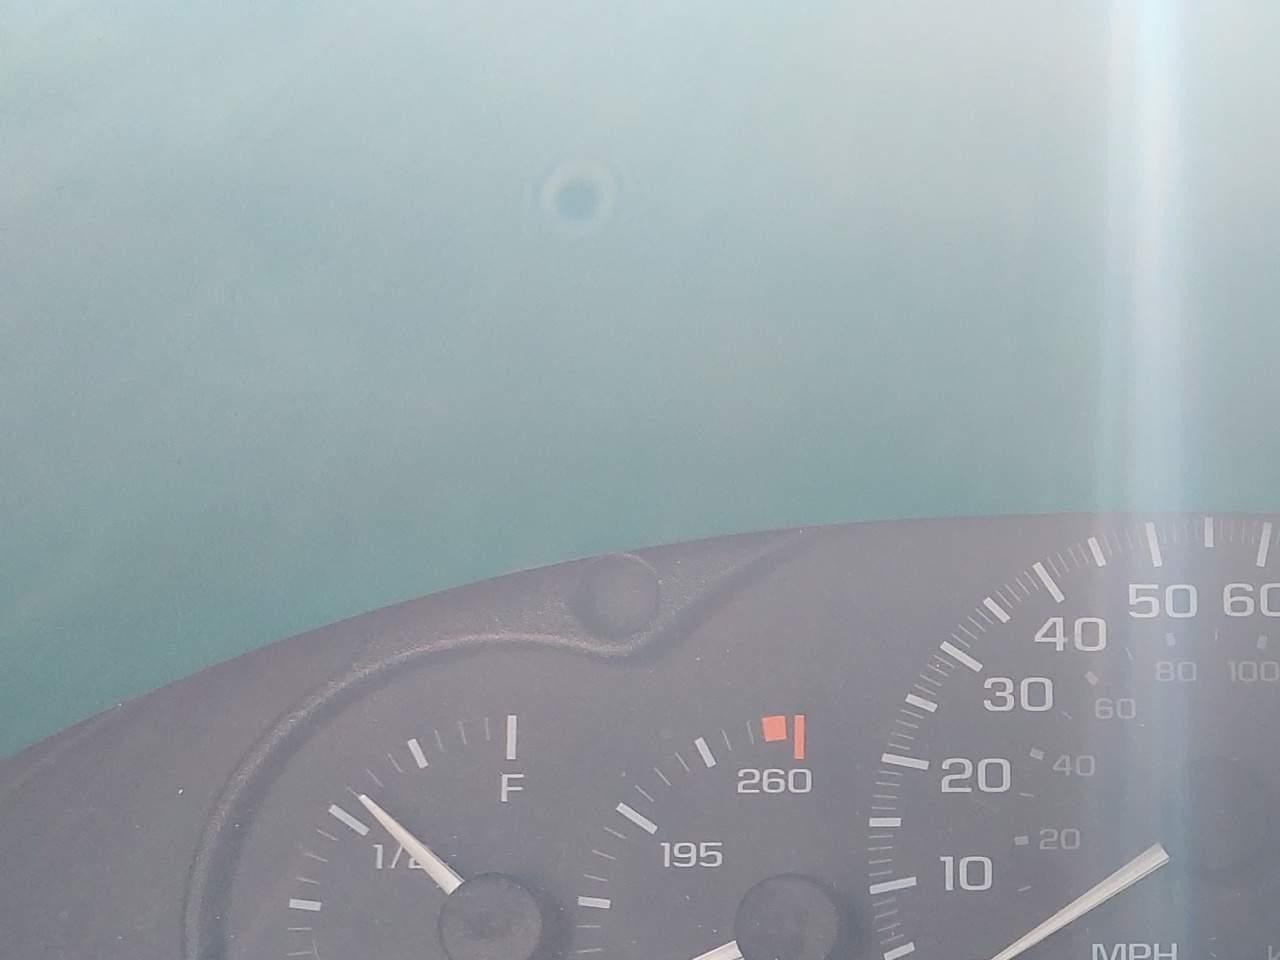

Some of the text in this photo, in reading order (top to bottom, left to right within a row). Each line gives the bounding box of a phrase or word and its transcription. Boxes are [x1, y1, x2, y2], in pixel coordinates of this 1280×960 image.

[1128, 583, 1198, 619] 50
[1033, 617, 1107, 652] 40
[1155, 660, 1197, 682] 80
[1228, 661, 1280, 682] 100
[983, 676, 1054, 712] 30
[1095, 698, 1136, 719] 60
[941, 757, 1011, 793] 20
[1052, 755, 1096, 777] 40
[500, 773, 524, 802] F
[737, 768, 812, 793] 260
[1039, 828, 1080, 850] 20
[660, 842, 722, 867] 195
[939, 855, 993, 891] 10
